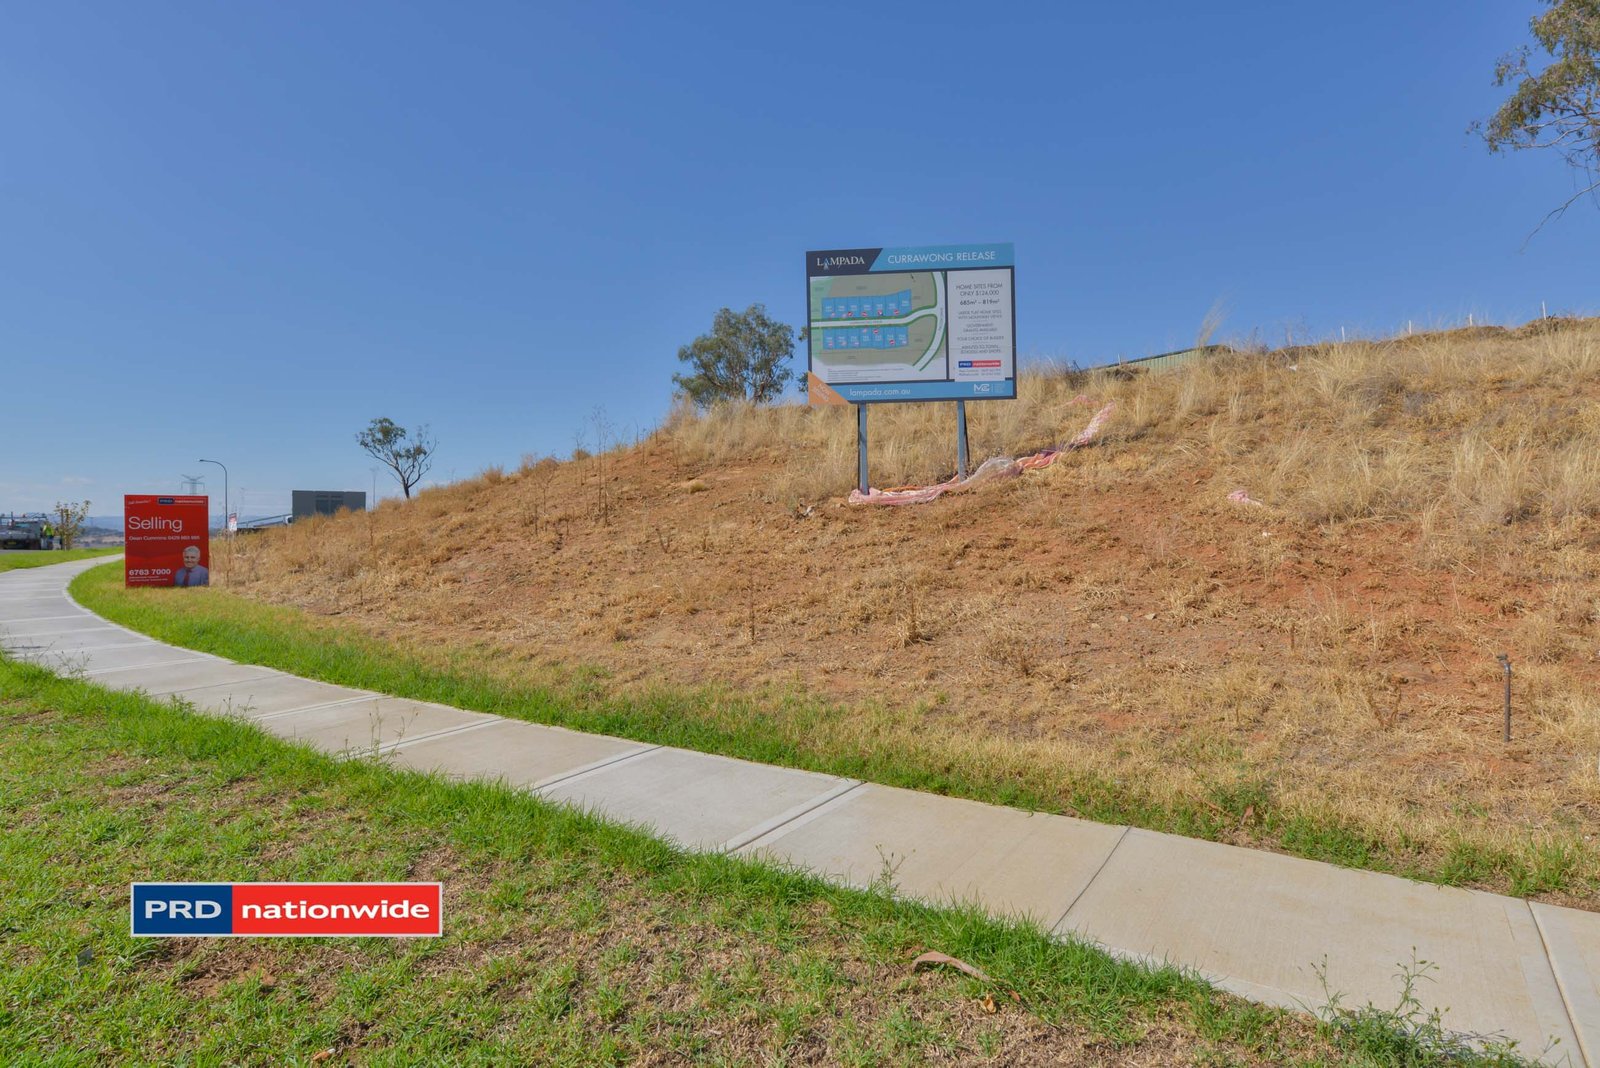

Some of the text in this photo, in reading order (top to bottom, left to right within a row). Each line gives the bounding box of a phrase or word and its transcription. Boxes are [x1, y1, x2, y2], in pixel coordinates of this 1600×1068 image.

[816, 255, 865, 269] LAMPADA
[888, 251, 995, 264] CURRAWONG RELEASE
[849, 388, 911, 398] lampada.com.au
[128, 516, 183, 532] Selling
